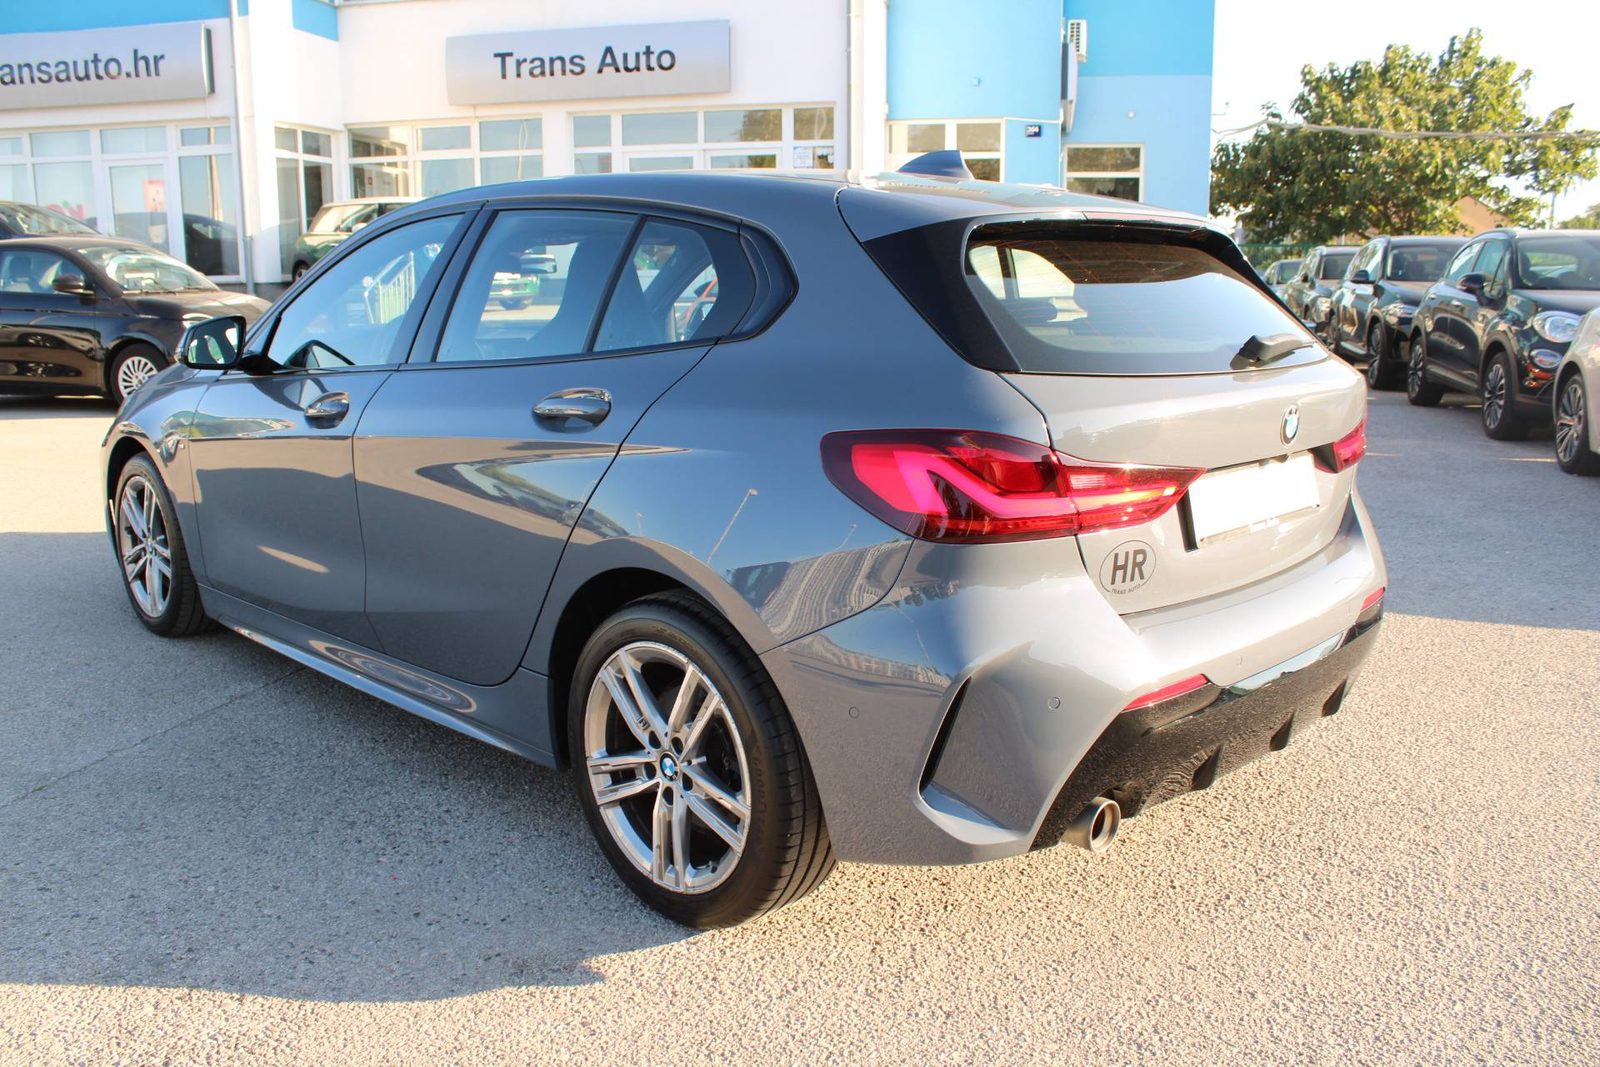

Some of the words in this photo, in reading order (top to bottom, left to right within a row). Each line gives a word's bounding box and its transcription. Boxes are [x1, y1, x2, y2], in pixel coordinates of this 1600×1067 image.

[0, 48, 165, 86] ansauto.hr
[493, 51, 586, 80] Trans
[596, 45, 677, 74] Auto
[1111, 549, 1147, 585] HR
